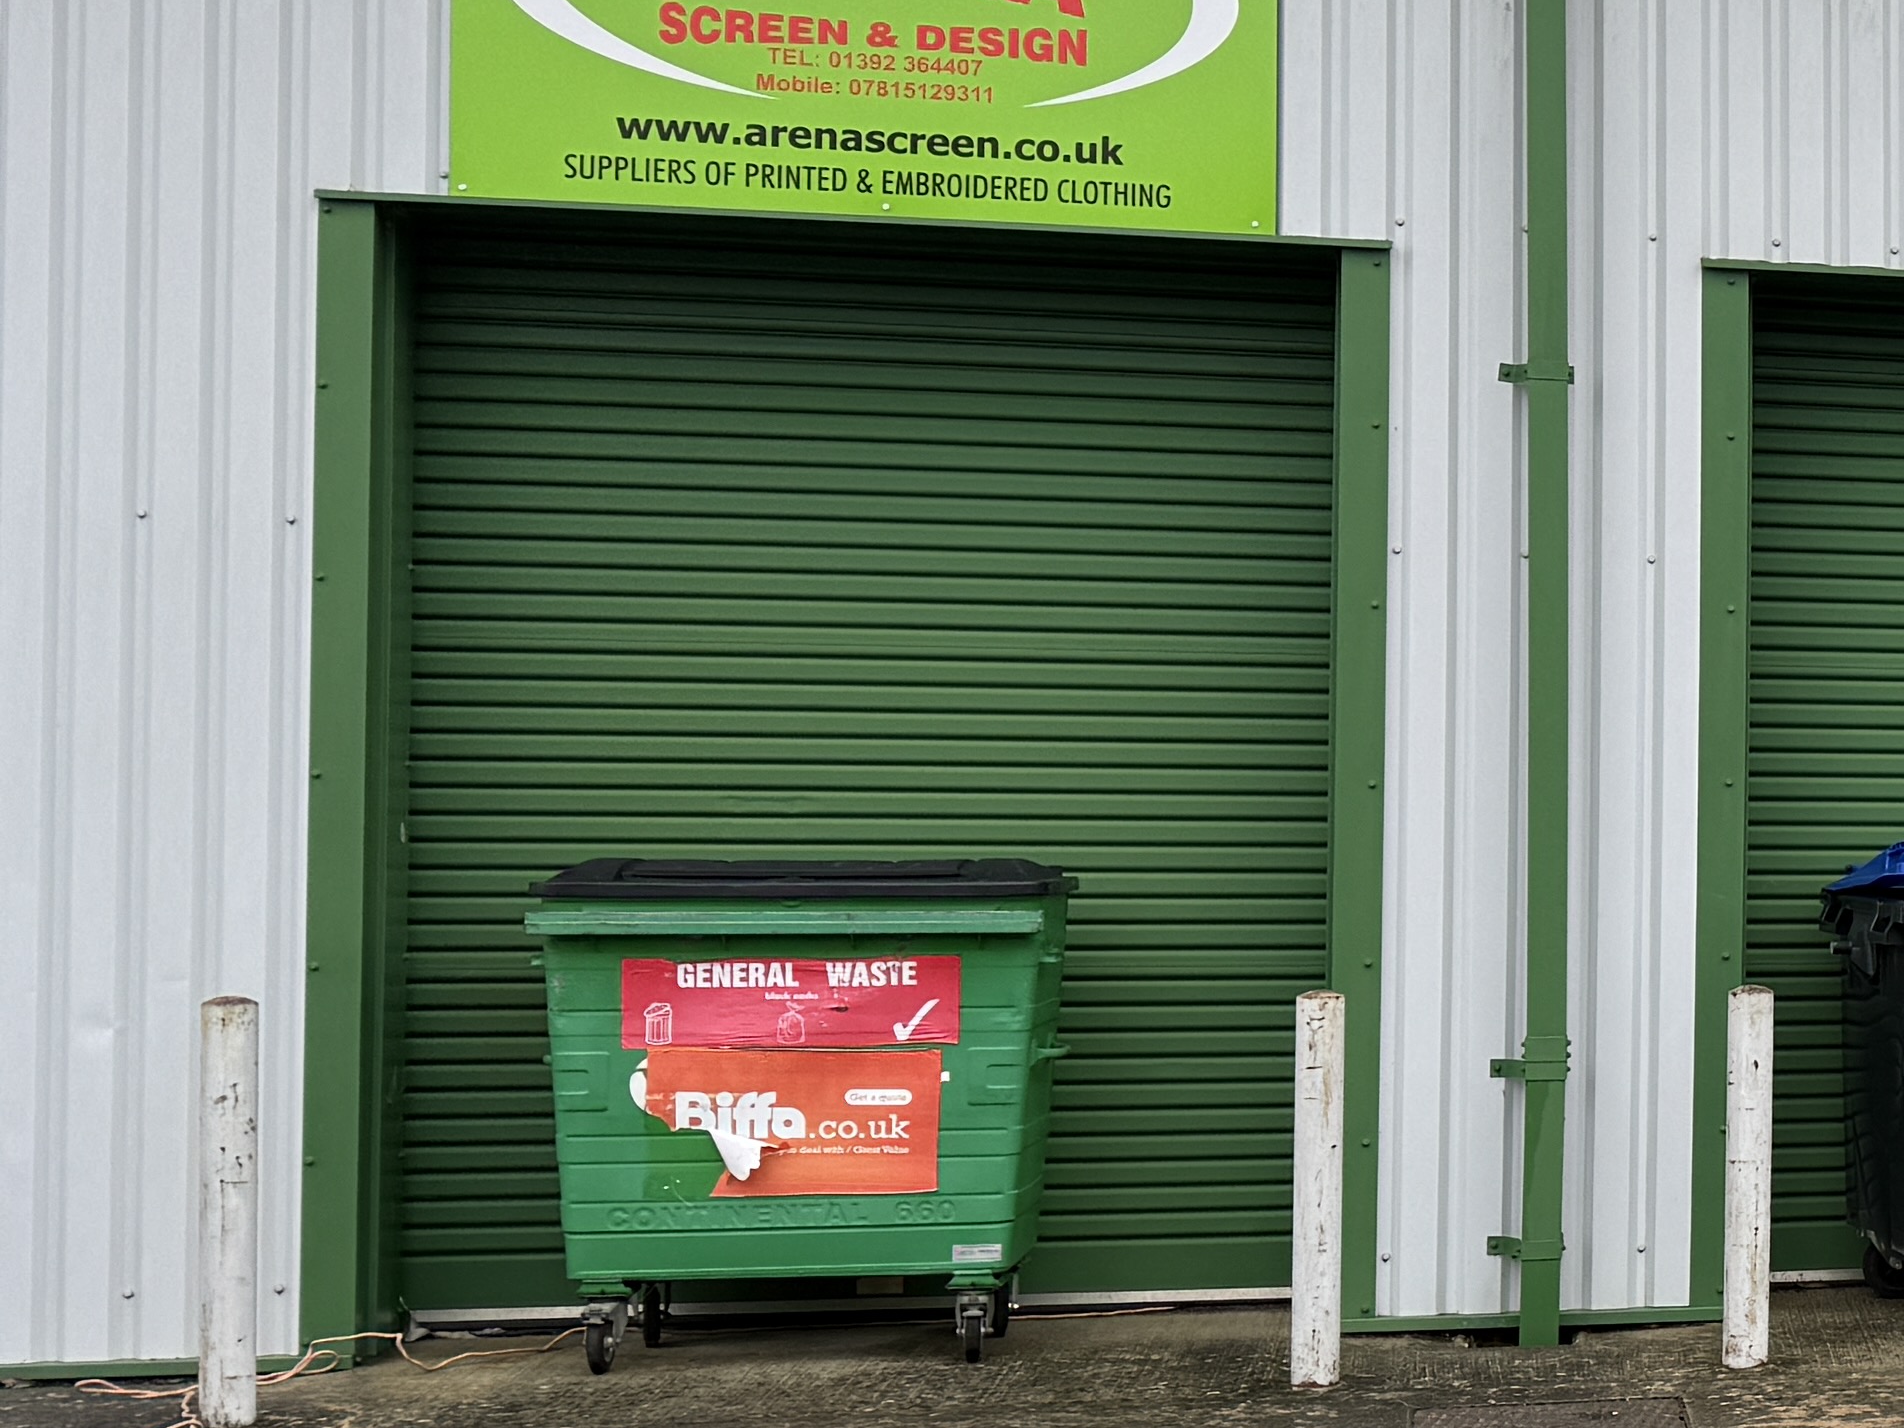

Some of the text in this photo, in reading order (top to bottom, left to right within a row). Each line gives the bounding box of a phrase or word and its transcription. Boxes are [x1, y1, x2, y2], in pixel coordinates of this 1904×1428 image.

[658, 1, 1088, 67] SCREEN & DESIGN
[767, 47, 983, 76] TEL: 01392 364407
[756, 72, 993, 104] Mobile: 07815129311
[616, 117, 1124, 166] www.arenascreen.co.uk
[564, 153, 1172, 209] SUPPLIERS OF PRINTED & EMBROIDERED CLOTHING
[677, 961, 917, 988] GENERAL WASTE
[675, 1091, 911, 1140] Biffa.co.uk
[895, 1199, 957, 1223] 660
